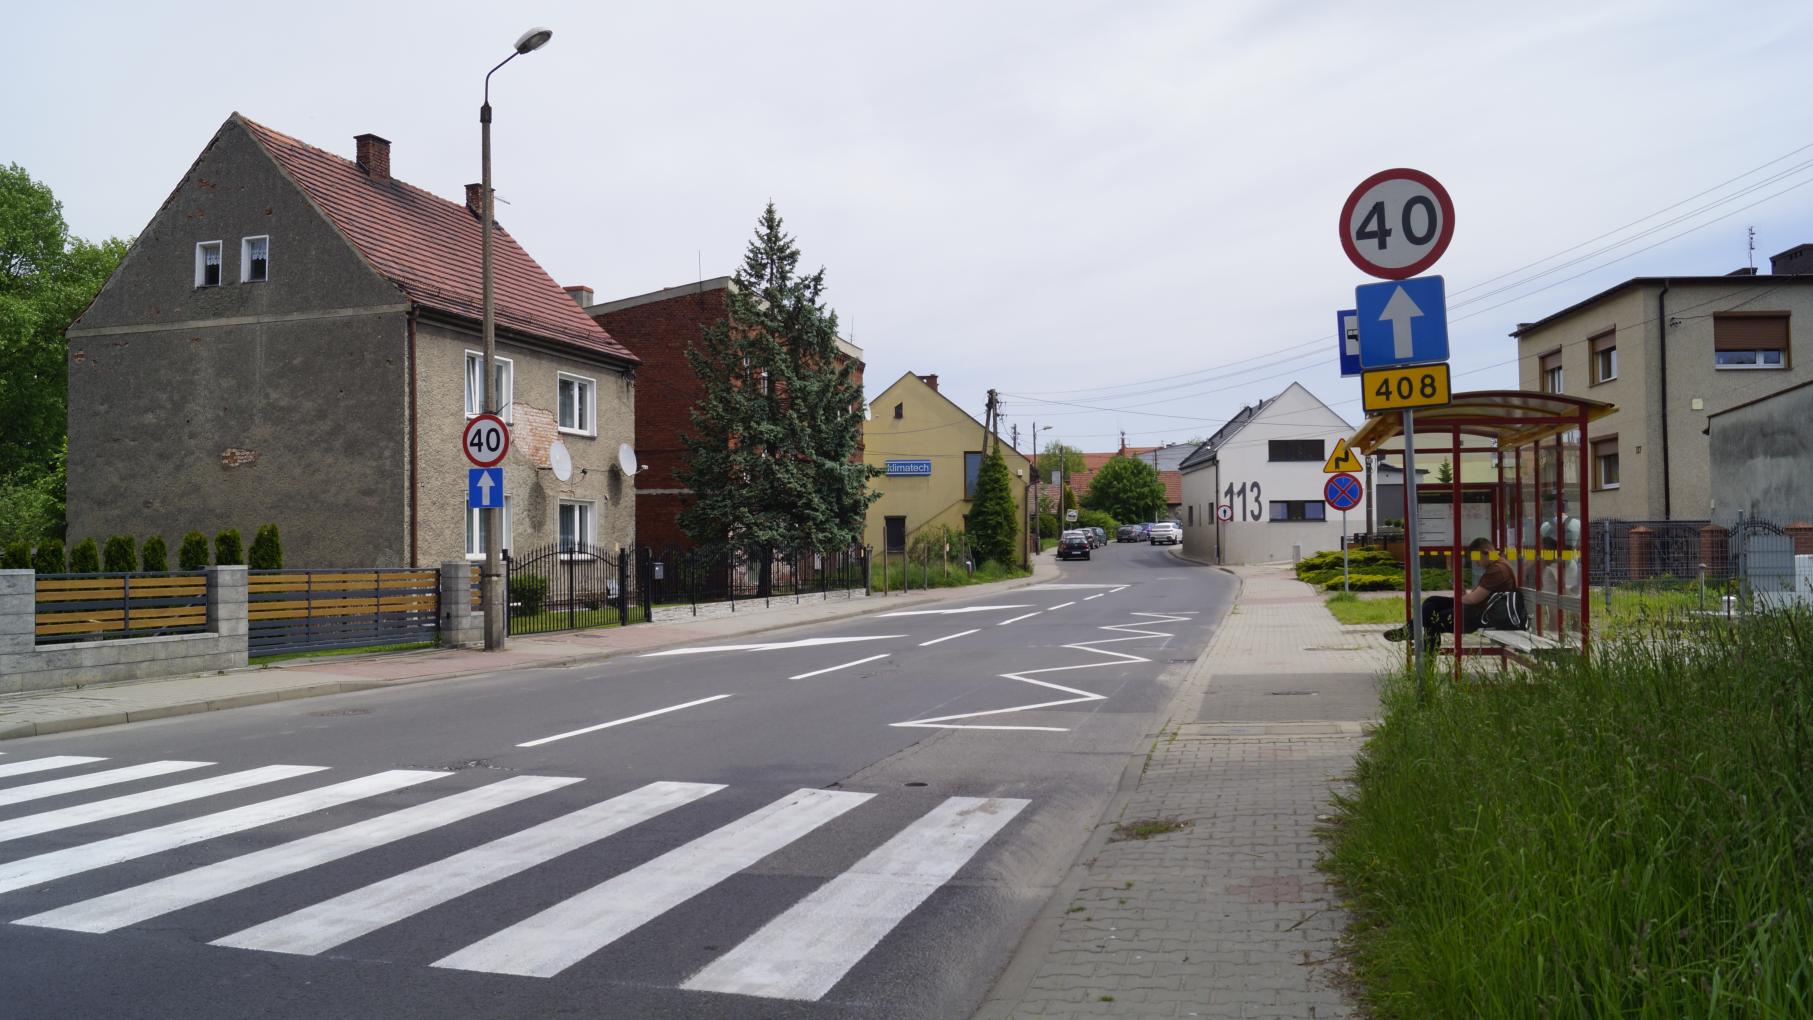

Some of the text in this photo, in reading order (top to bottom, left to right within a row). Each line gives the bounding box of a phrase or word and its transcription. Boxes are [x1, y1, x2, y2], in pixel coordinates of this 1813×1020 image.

[1356, 195, 1437, 250] 40
[1375, 374, 1437, 402] 408
[469, 427, 501, 453] 40
[1224, 480, 1263, 522] 113
